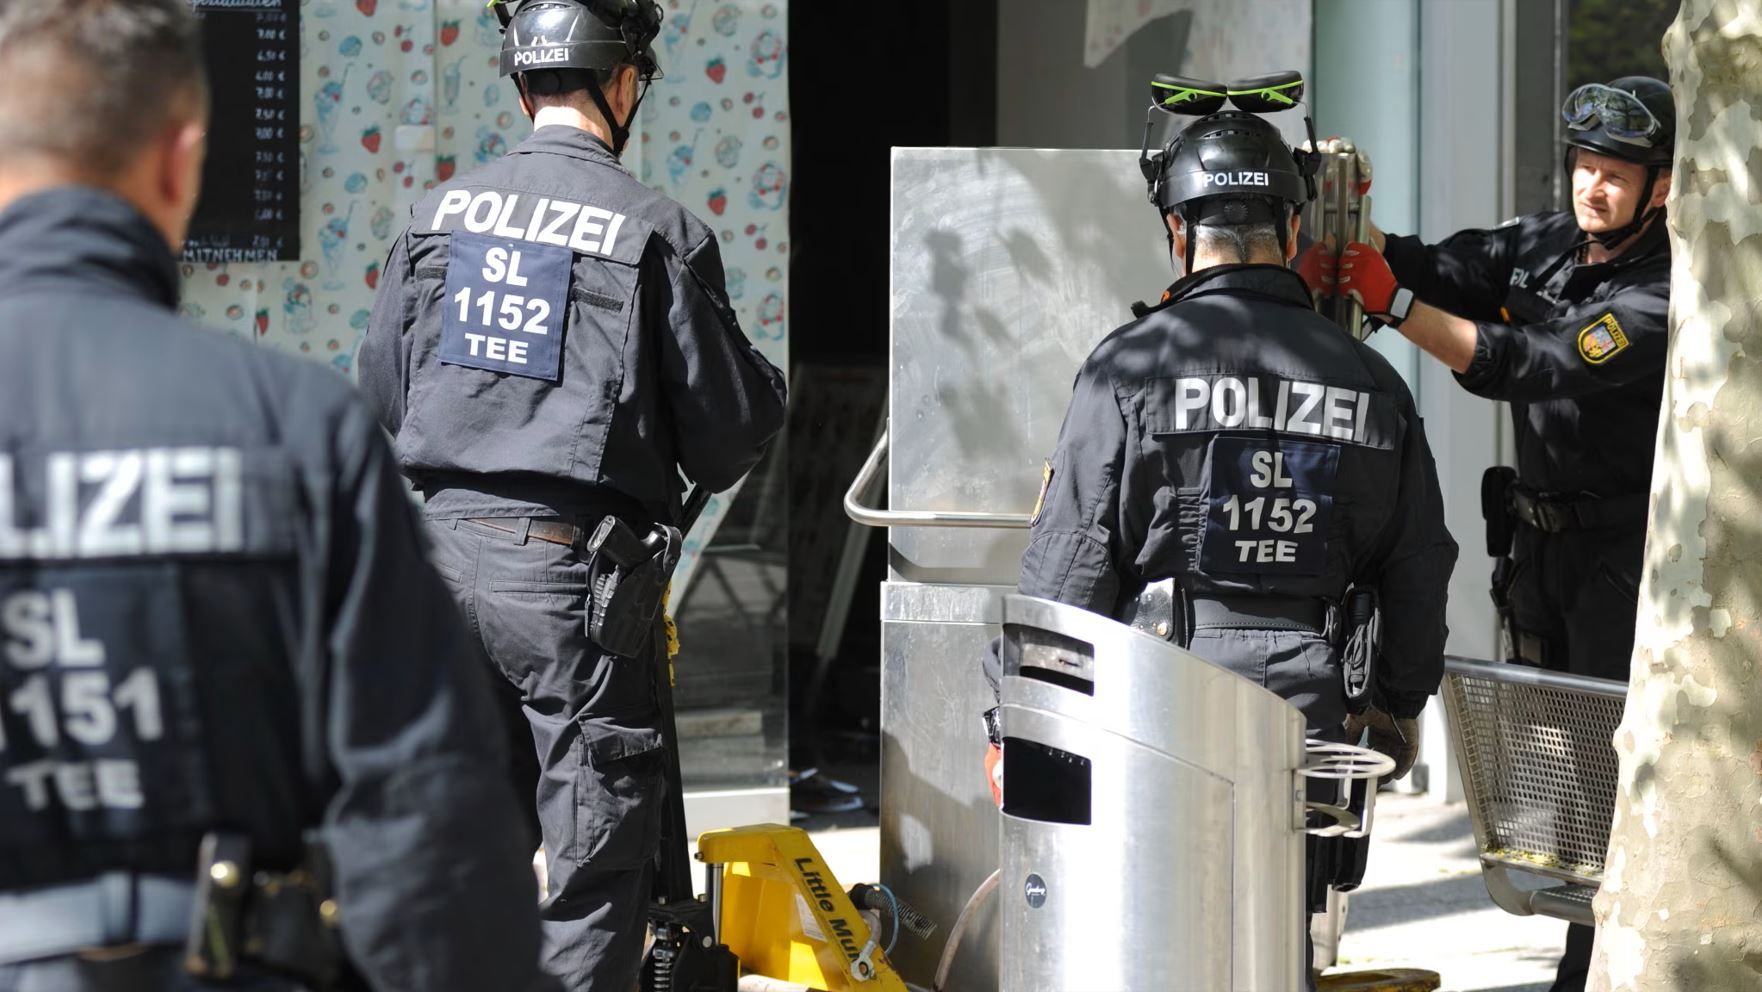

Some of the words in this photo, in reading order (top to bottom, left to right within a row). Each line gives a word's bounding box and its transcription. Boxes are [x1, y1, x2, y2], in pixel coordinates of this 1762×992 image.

[514, 47, 569, 66] POLIZEI
[1203, 172, 1269, 187] POLIZEI
[431, 189, 626, 256] POLIZEI
[482, 247, 528, 287] SL
[454, 287, 551, 335] 1152
[465, 333, 529, 364] TEE
[1603, 316, 1627, 348] POLIZEI
[1175, 377, 1370, 442] POLIZEI
[1250, 451, 1293, 488] SL
[1223, 494, 1317, 534] 1152
[1235, 539, 1299, 563] TEE
[3, 587, 105, 669] SL
[0, 665, 163, 752] 151
[5, 757, 145, 812] TEE
[795, 858, 834, 912] Little
[828, 918, 861, 963] Mul
